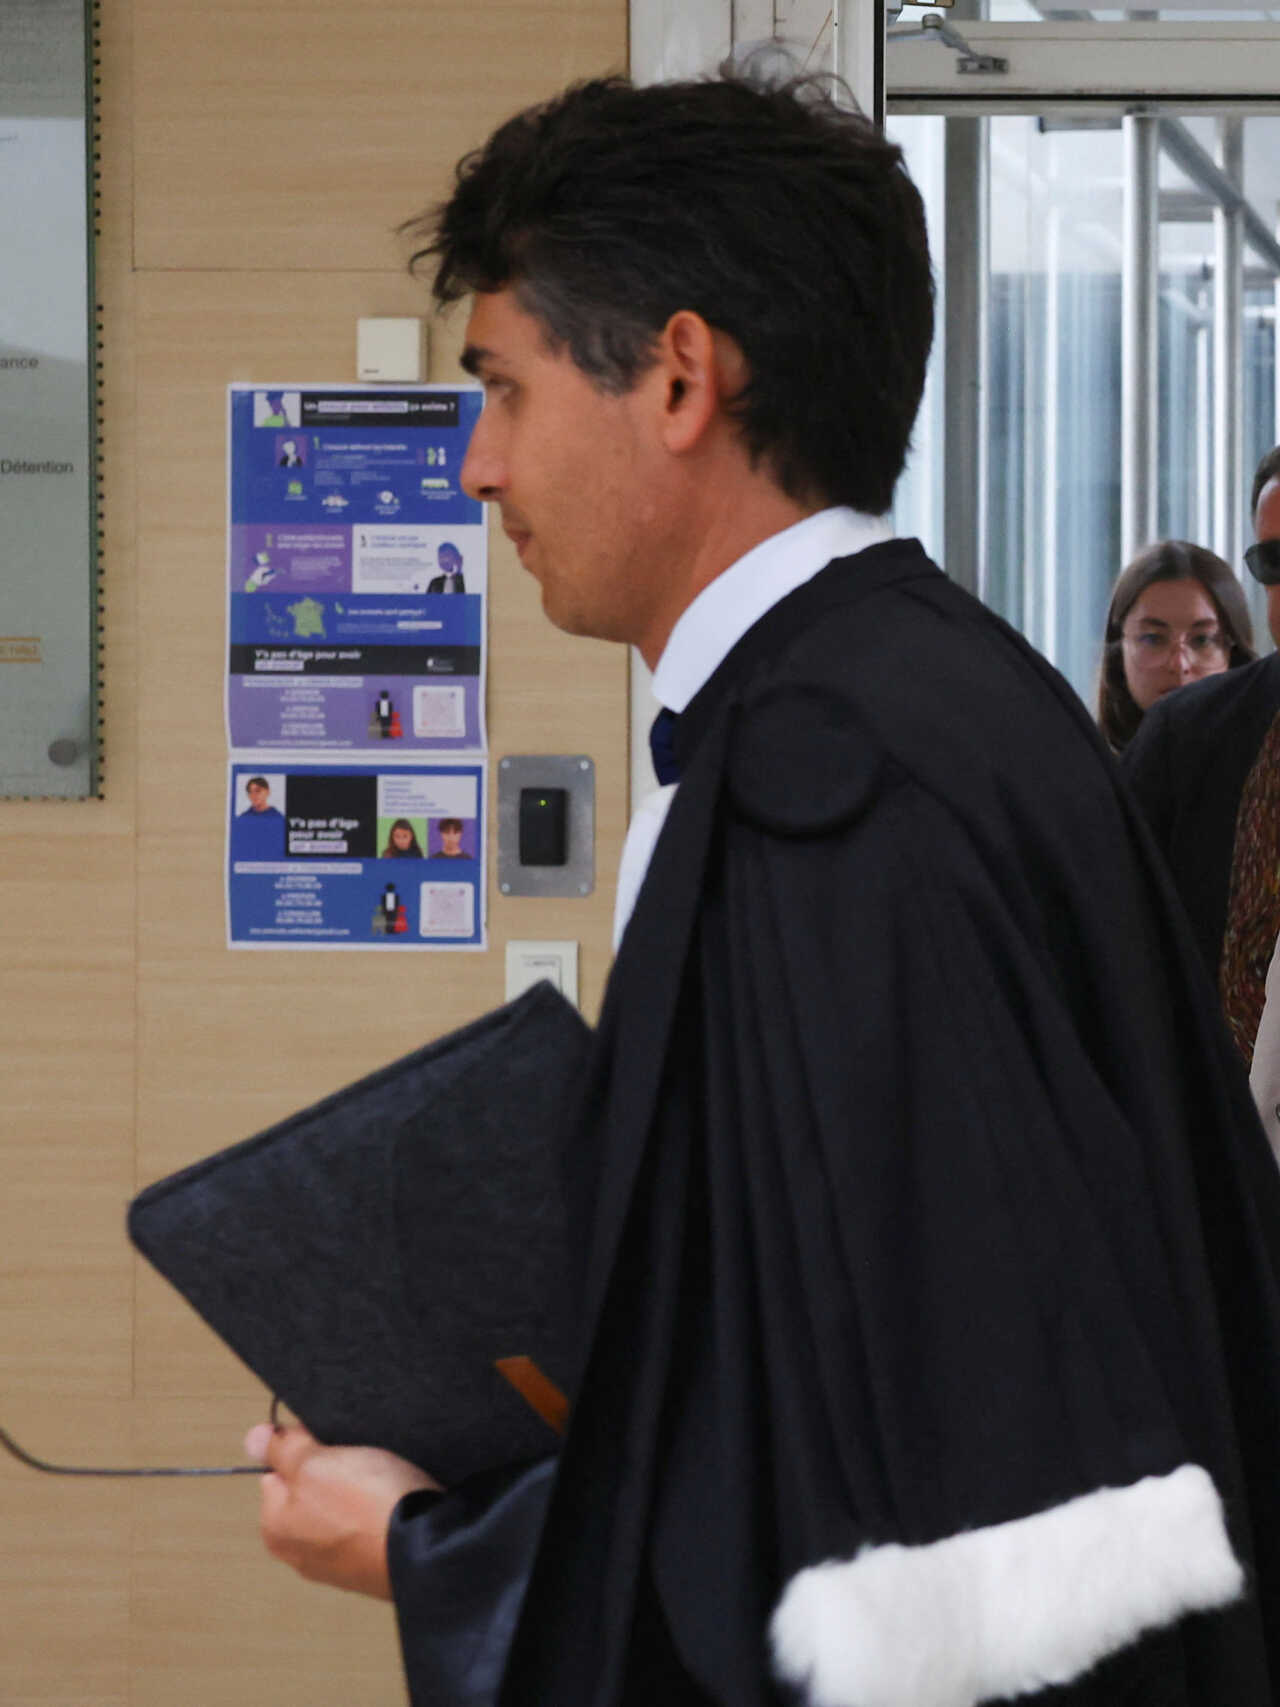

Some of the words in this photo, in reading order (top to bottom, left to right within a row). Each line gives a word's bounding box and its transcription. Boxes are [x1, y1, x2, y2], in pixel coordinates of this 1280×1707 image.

[1, 458, 74, 473] Détention
[289, 830, 313, 841] pour
[316, 830, 344, 840] avoir
